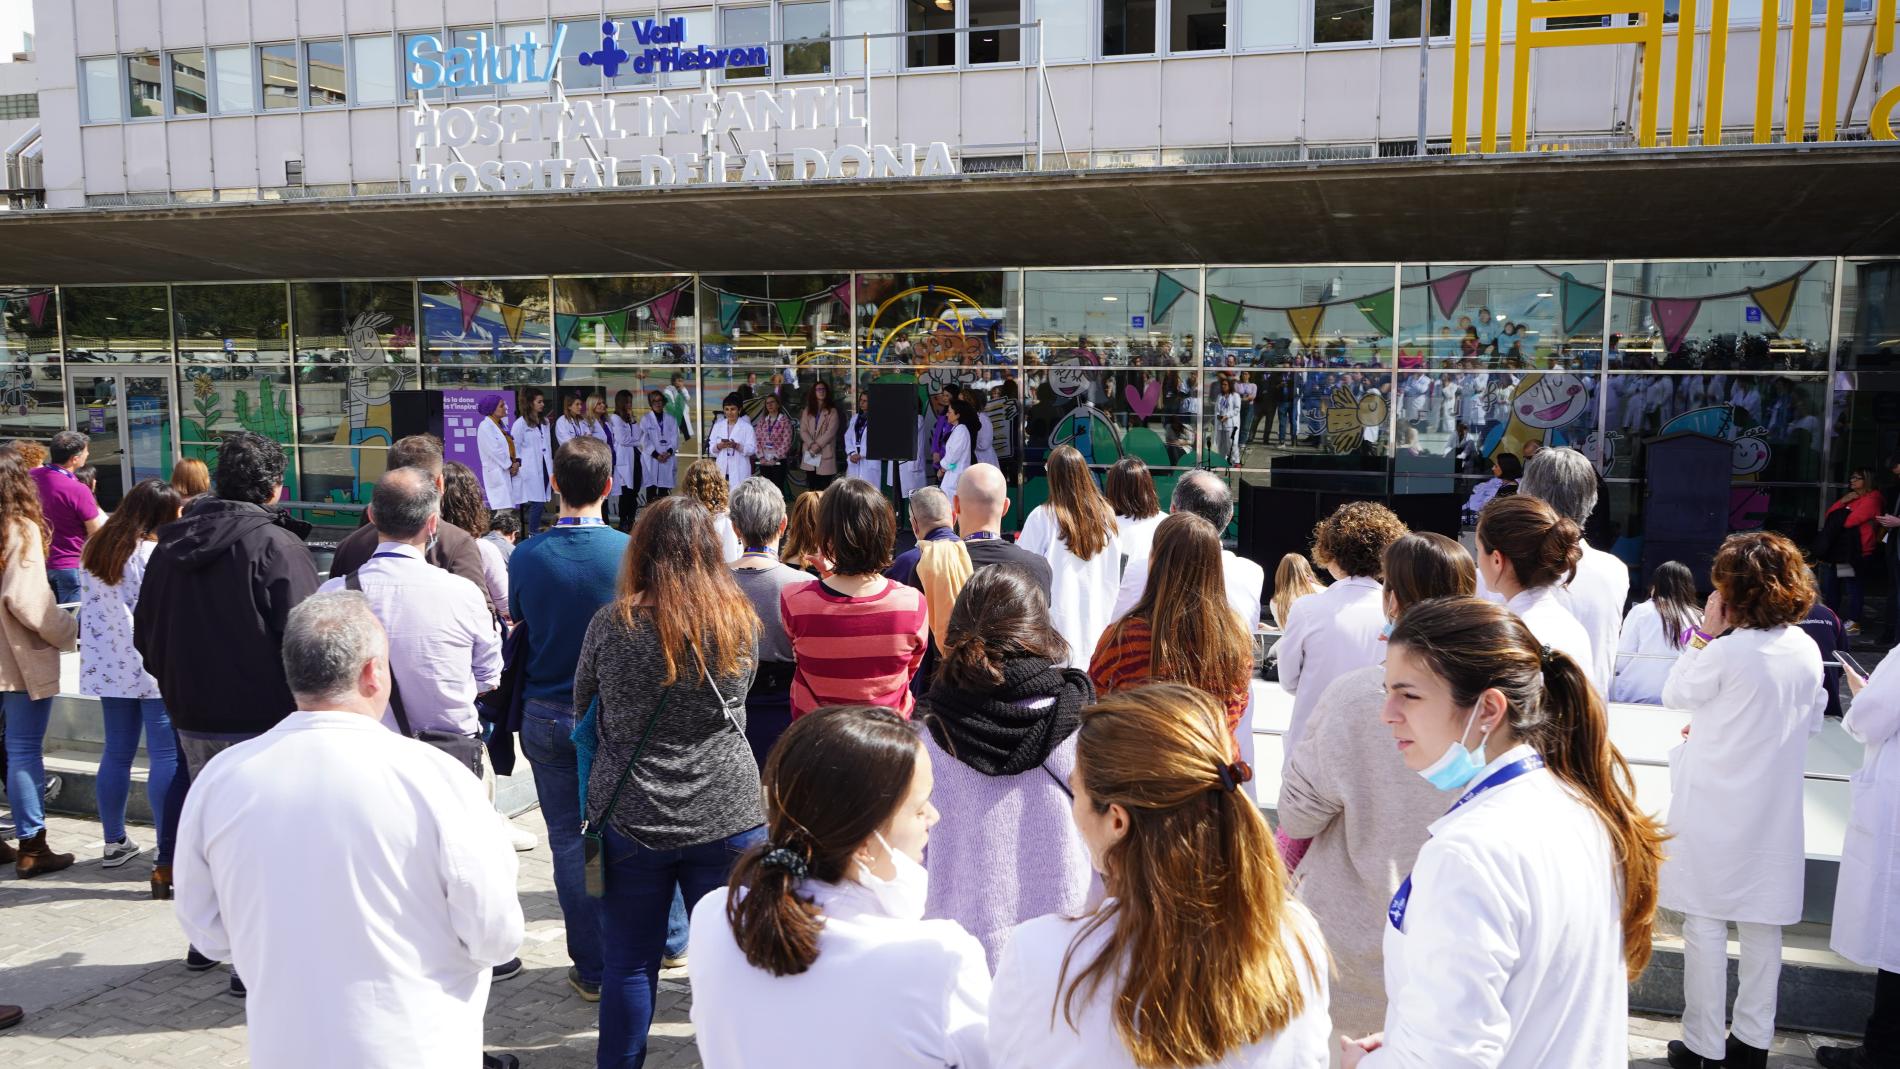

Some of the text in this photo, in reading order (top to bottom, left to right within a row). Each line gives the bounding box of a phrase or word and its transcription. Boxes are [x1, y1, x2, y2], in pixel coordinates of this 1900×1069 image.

[632, 17, 687, 44] Vall
[633, 45, 768, 74] d'Hebron
[408, 85, 867, 148] HOSPITAL INFANTIL
[410, 142, 956, 193] HOSPITAL DE LA DONA
